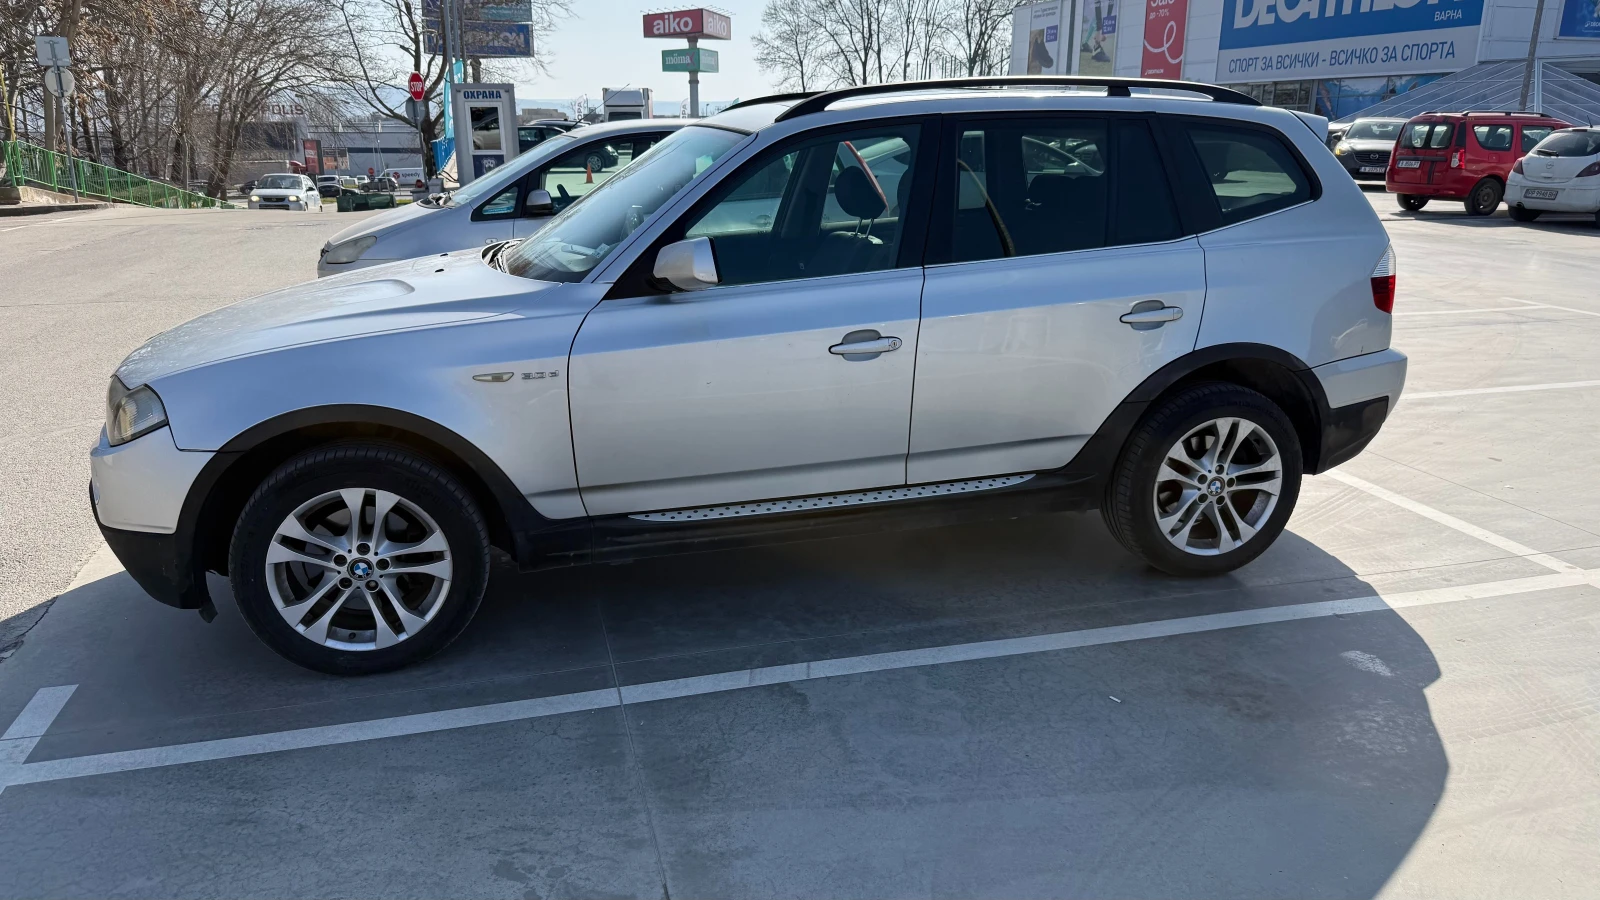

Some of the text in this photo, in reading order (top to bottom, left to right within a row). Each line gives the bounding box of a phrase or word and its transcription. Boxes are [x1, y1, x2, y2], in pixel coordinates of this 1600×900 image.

[1434, 9, 1462, 21] ВАРНА
[653, 14, 692, 34] aiko
[708, 14, 726, 36] aiko
[1228, 57, 1259, 73] СПОРТ
[1260, 56, 1273, 71] ЗА
[1276, 52, 1319, 70] ВСИЧКИ
[1330, 46, 1378, 66] ВСИЧКО
[1380, 46, 1397, 62] ЗА
[1401, 40, 1455, 62] СПОРТА
[410, 81, 422, 92] STOP
[464, 90, 502, 99] ОХРАНА
